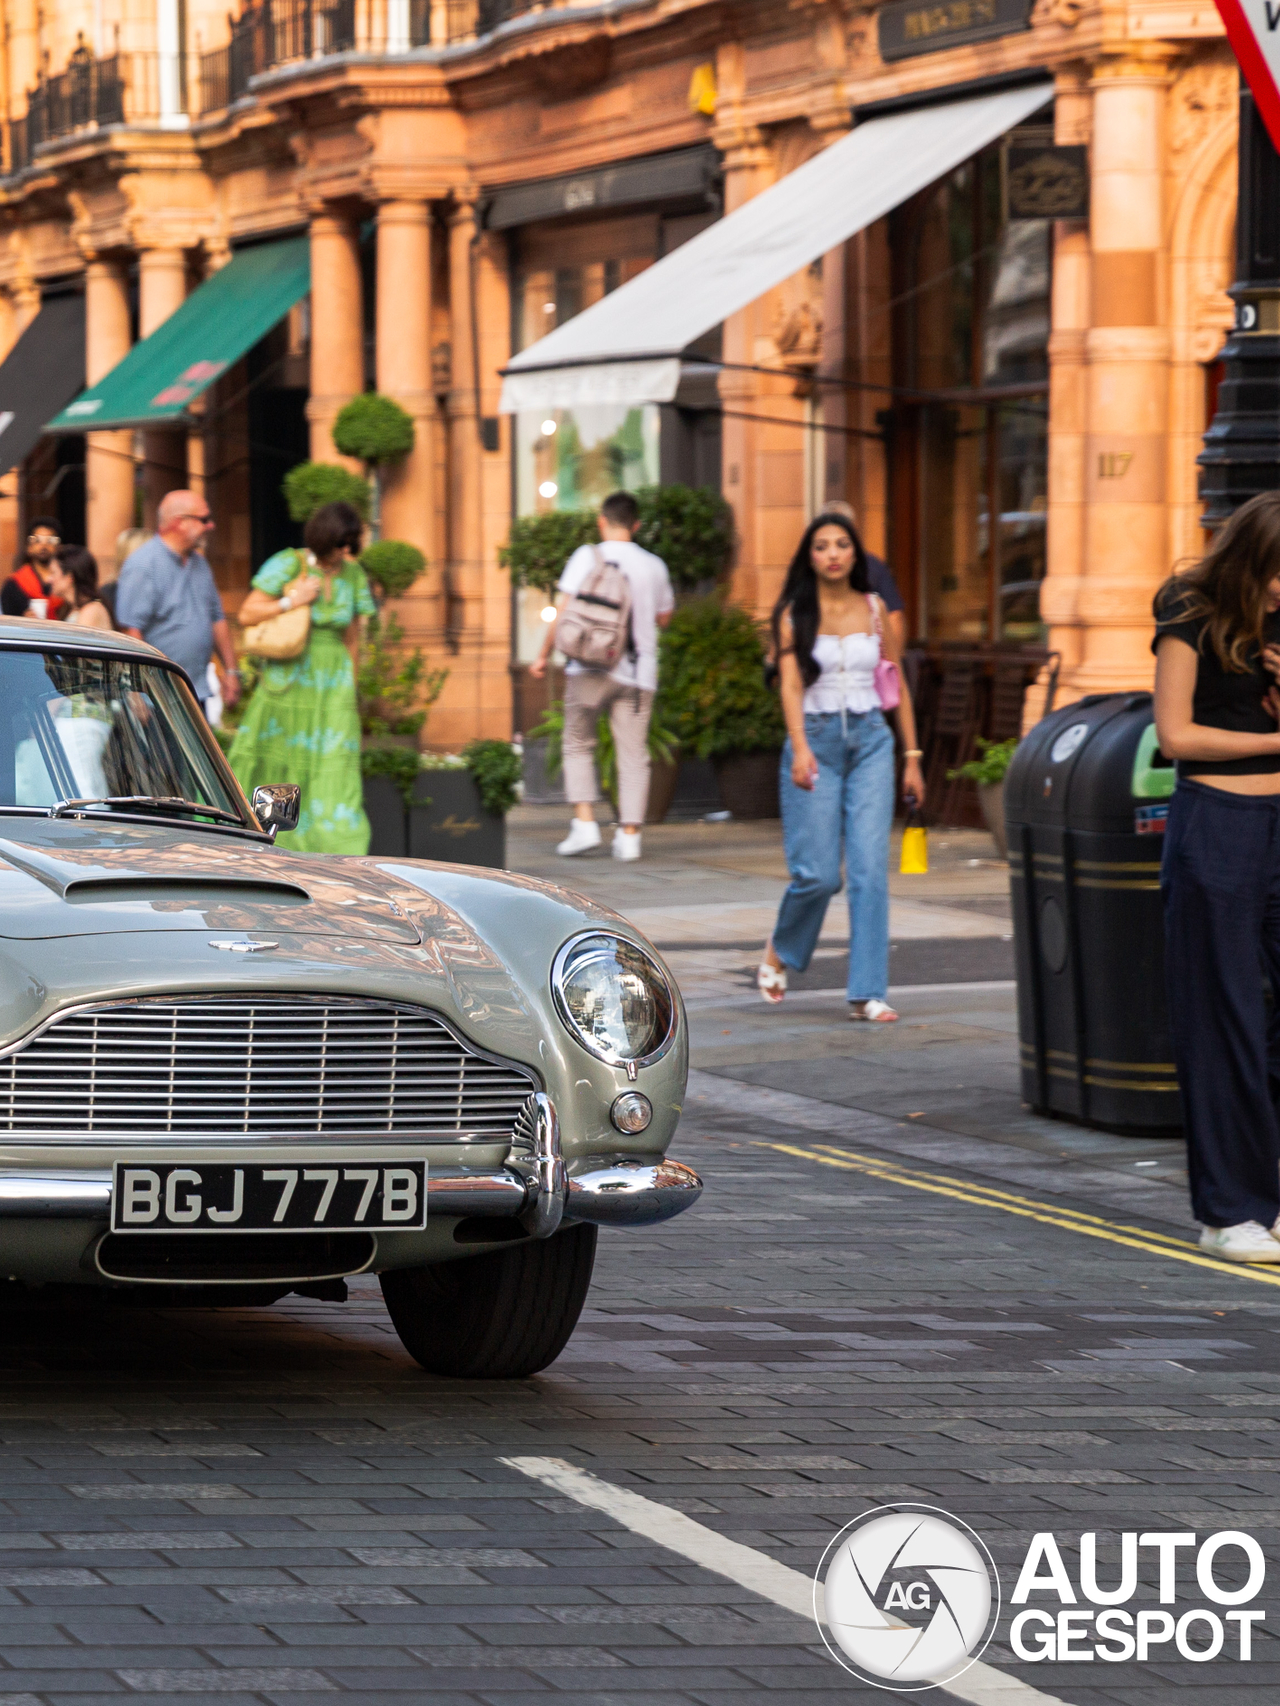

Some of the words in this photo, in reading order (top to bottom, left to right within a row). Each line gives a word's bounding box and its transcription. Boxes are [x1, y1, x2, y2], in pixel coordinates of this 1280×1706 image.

[1099, 452, 1132, 478] 117
[122, 1168, 245, 1223] BGJ
[262, 1168, 418, 1222] 777B
